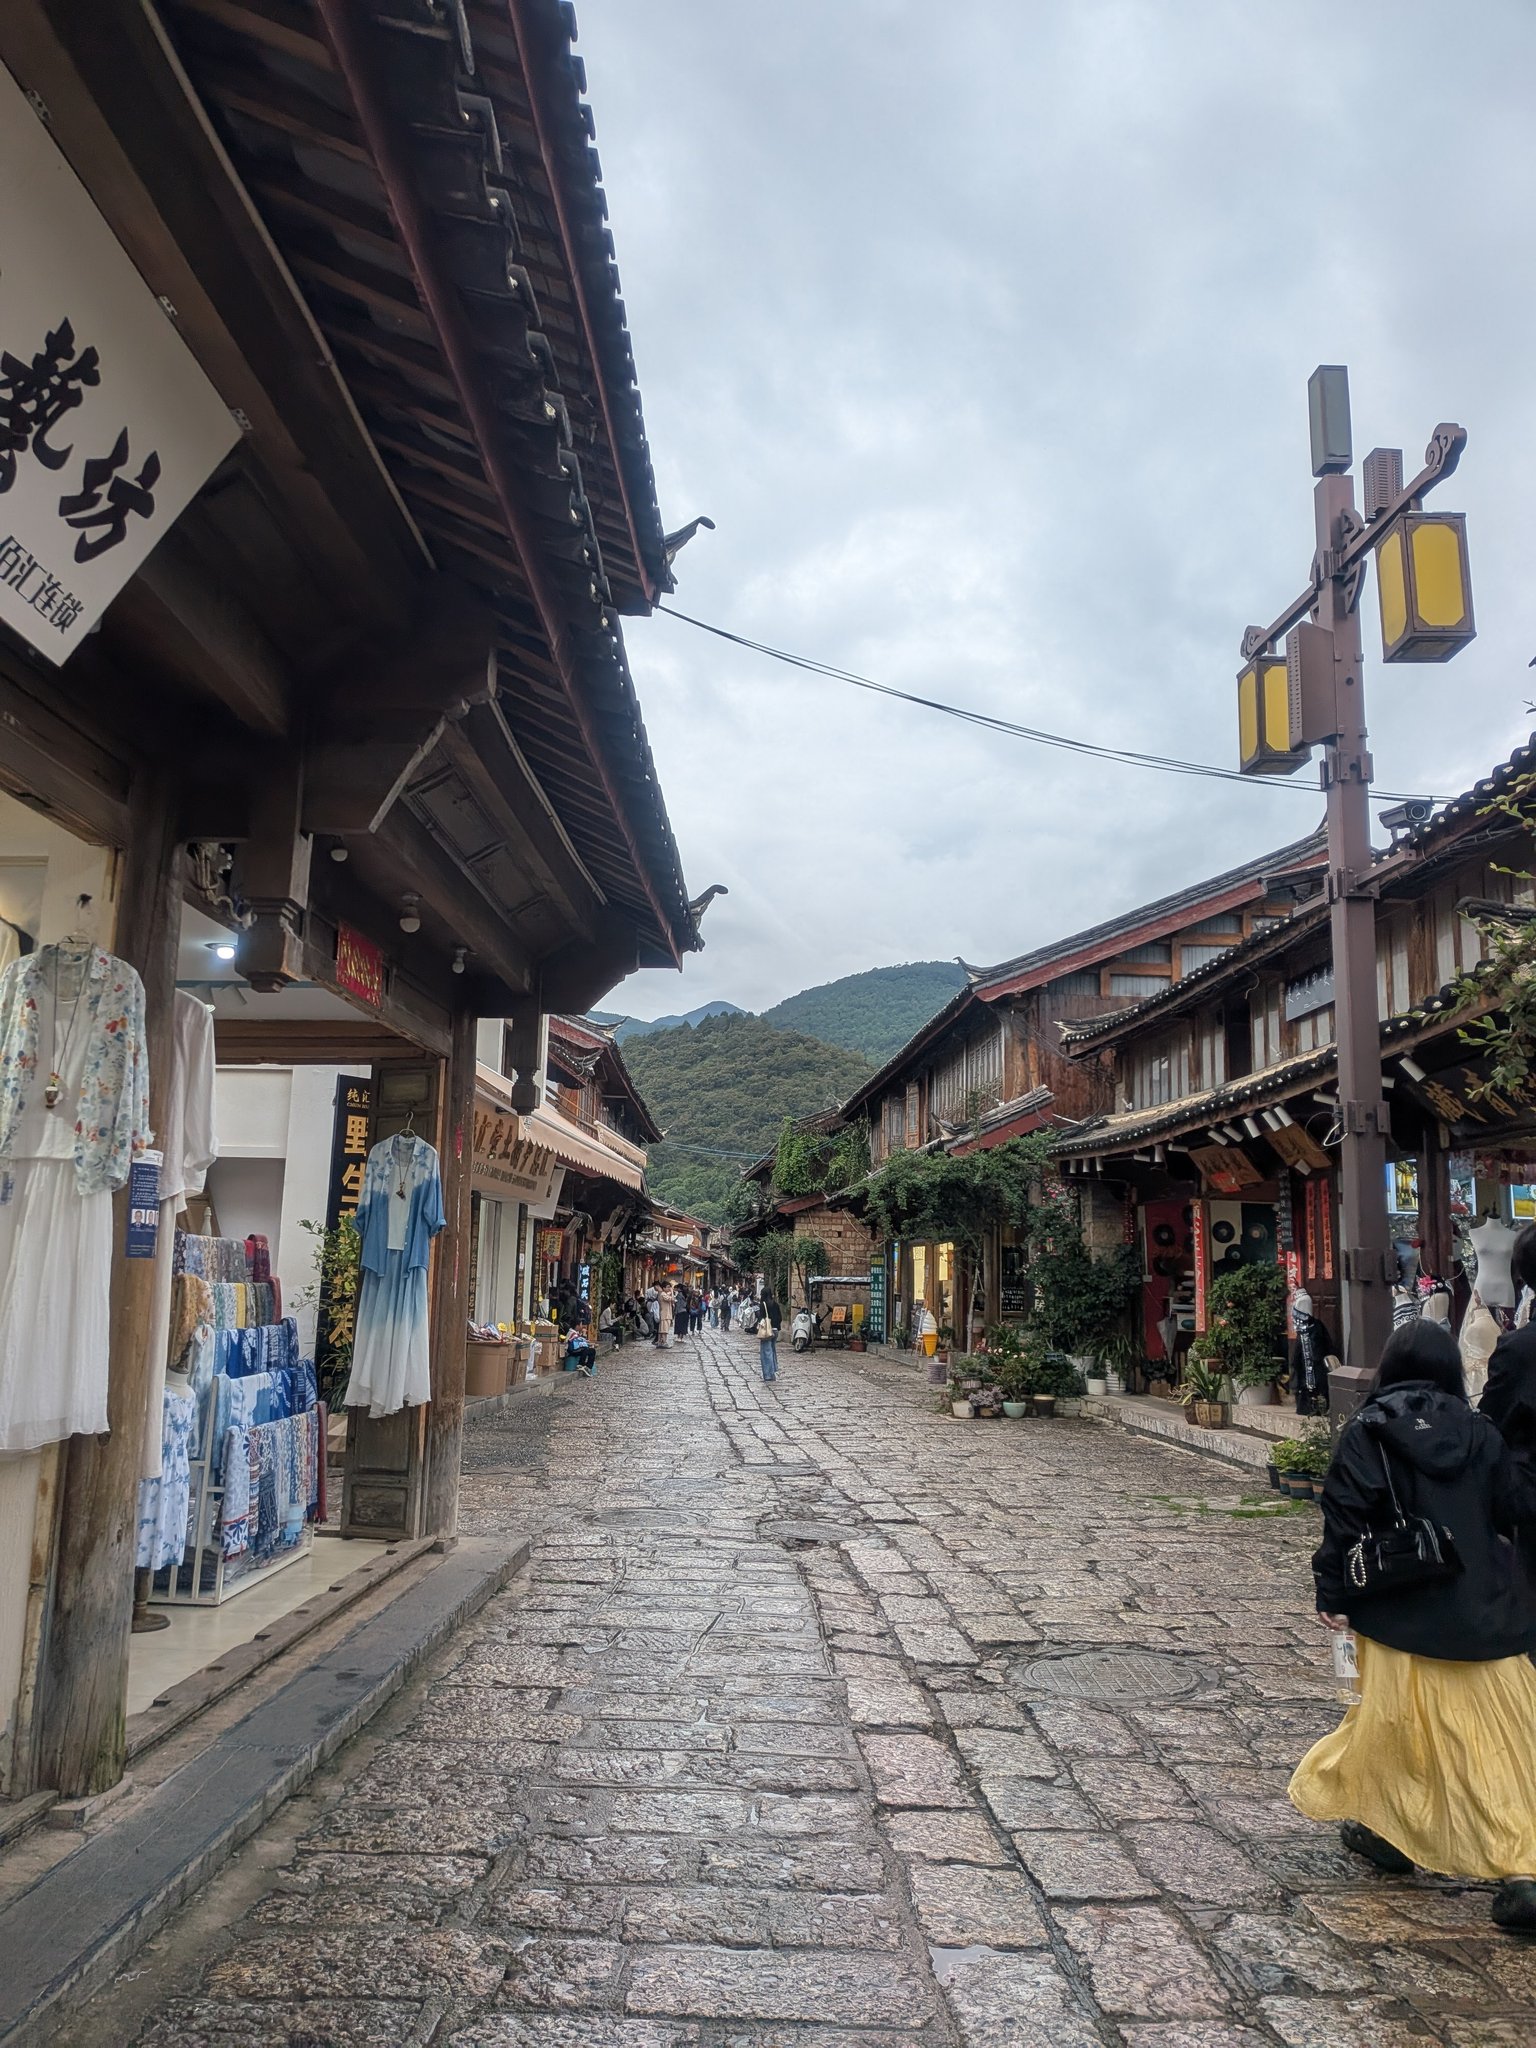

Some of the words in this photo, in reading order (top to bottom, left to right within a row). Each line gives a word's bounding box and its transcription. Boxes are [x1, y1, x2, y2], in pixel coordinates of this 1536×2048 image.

[0, 535, 84, 634] 佰汇连锁
[347, 1088, 370, 1103] 纯汇
